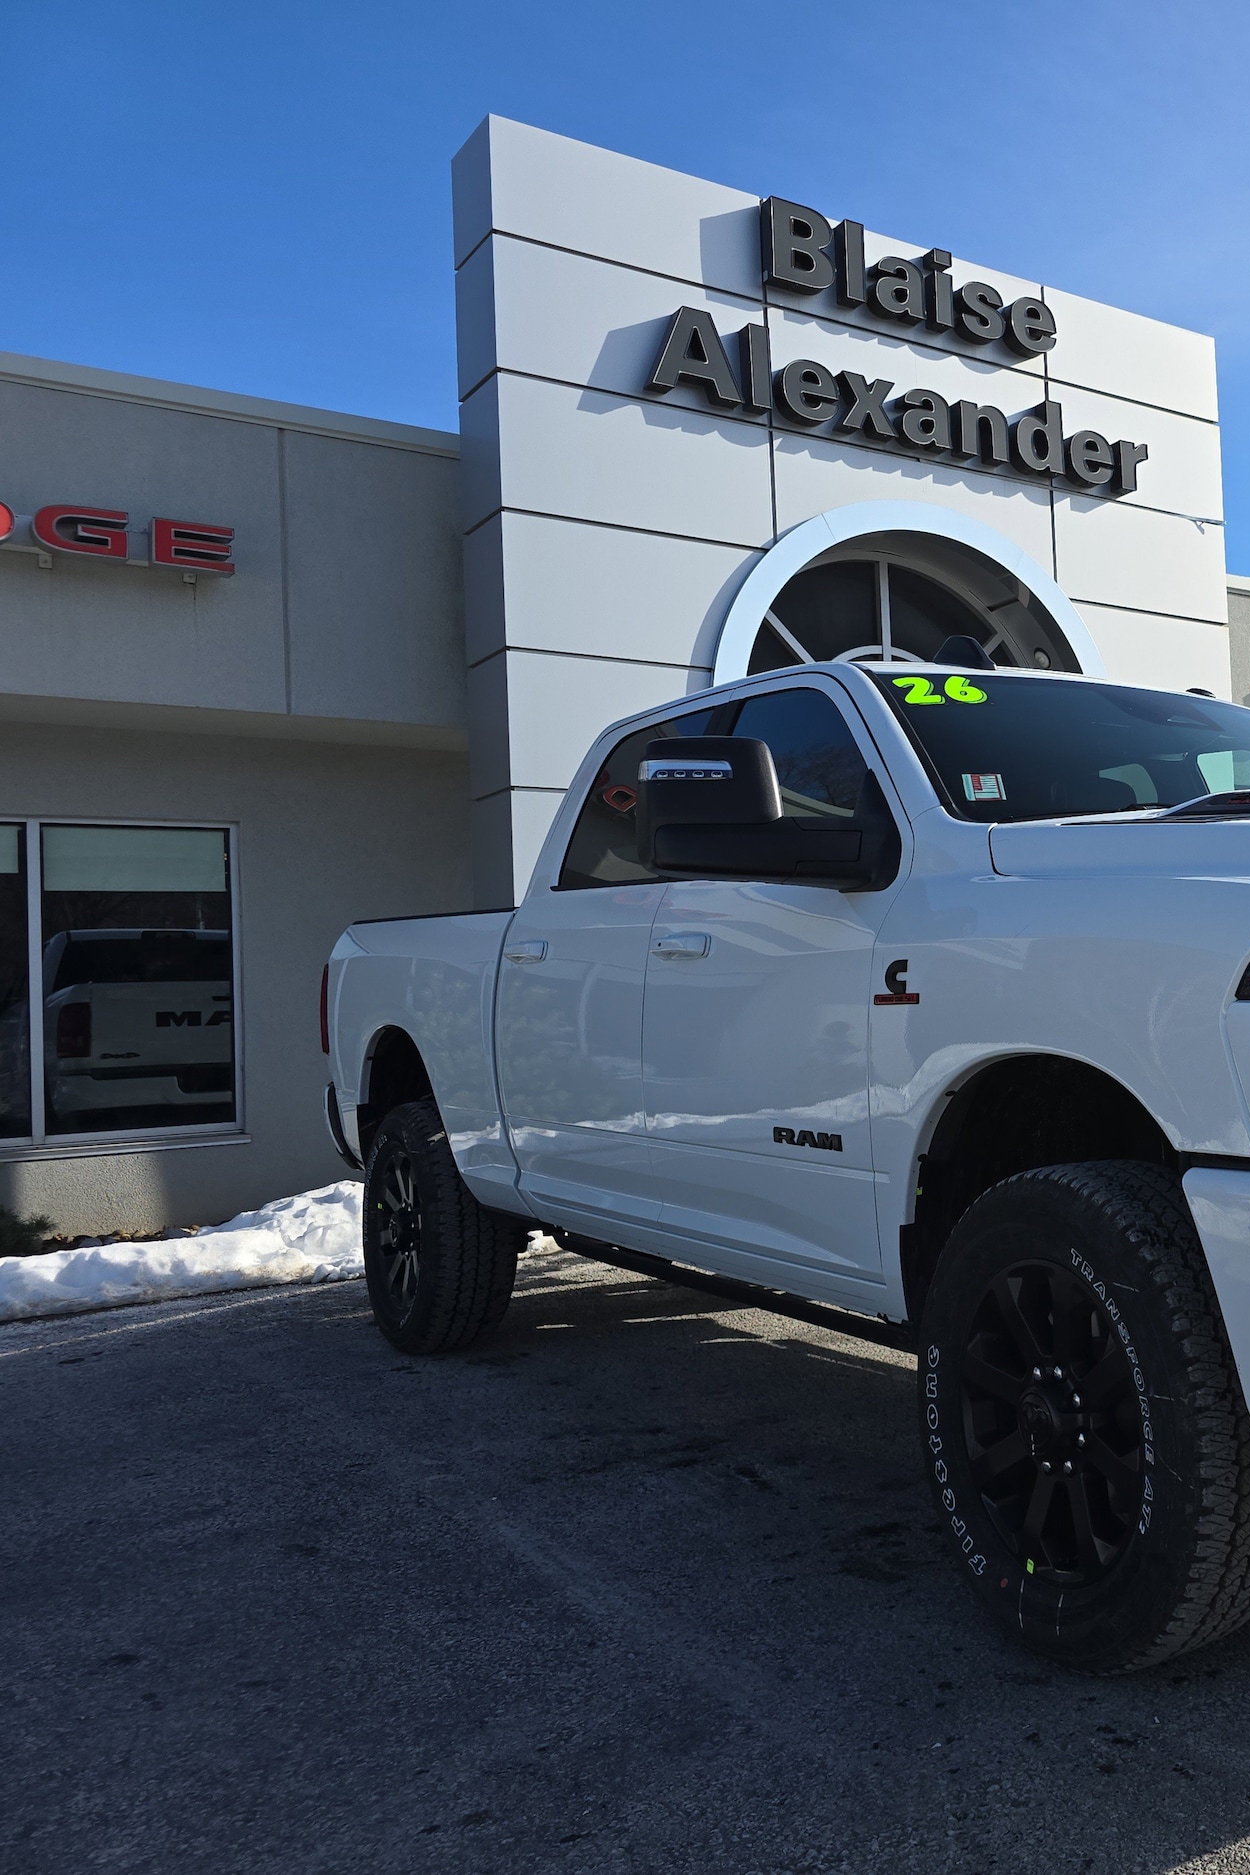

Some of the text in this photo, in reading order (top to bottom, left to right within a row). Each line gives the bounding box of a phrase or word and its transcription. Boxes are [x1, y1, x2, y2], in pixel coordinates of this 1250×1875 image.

[761, 195, 1057, 358] Blaise
[644, 306, 1148, 497] Alexander
[0, 499, 236, 578] GE
[891, 676, 989, 705] 26
[773, 1126, 843, 1152] RAM
[1070, 1248, 1155, 1466] TRANSFORCE
